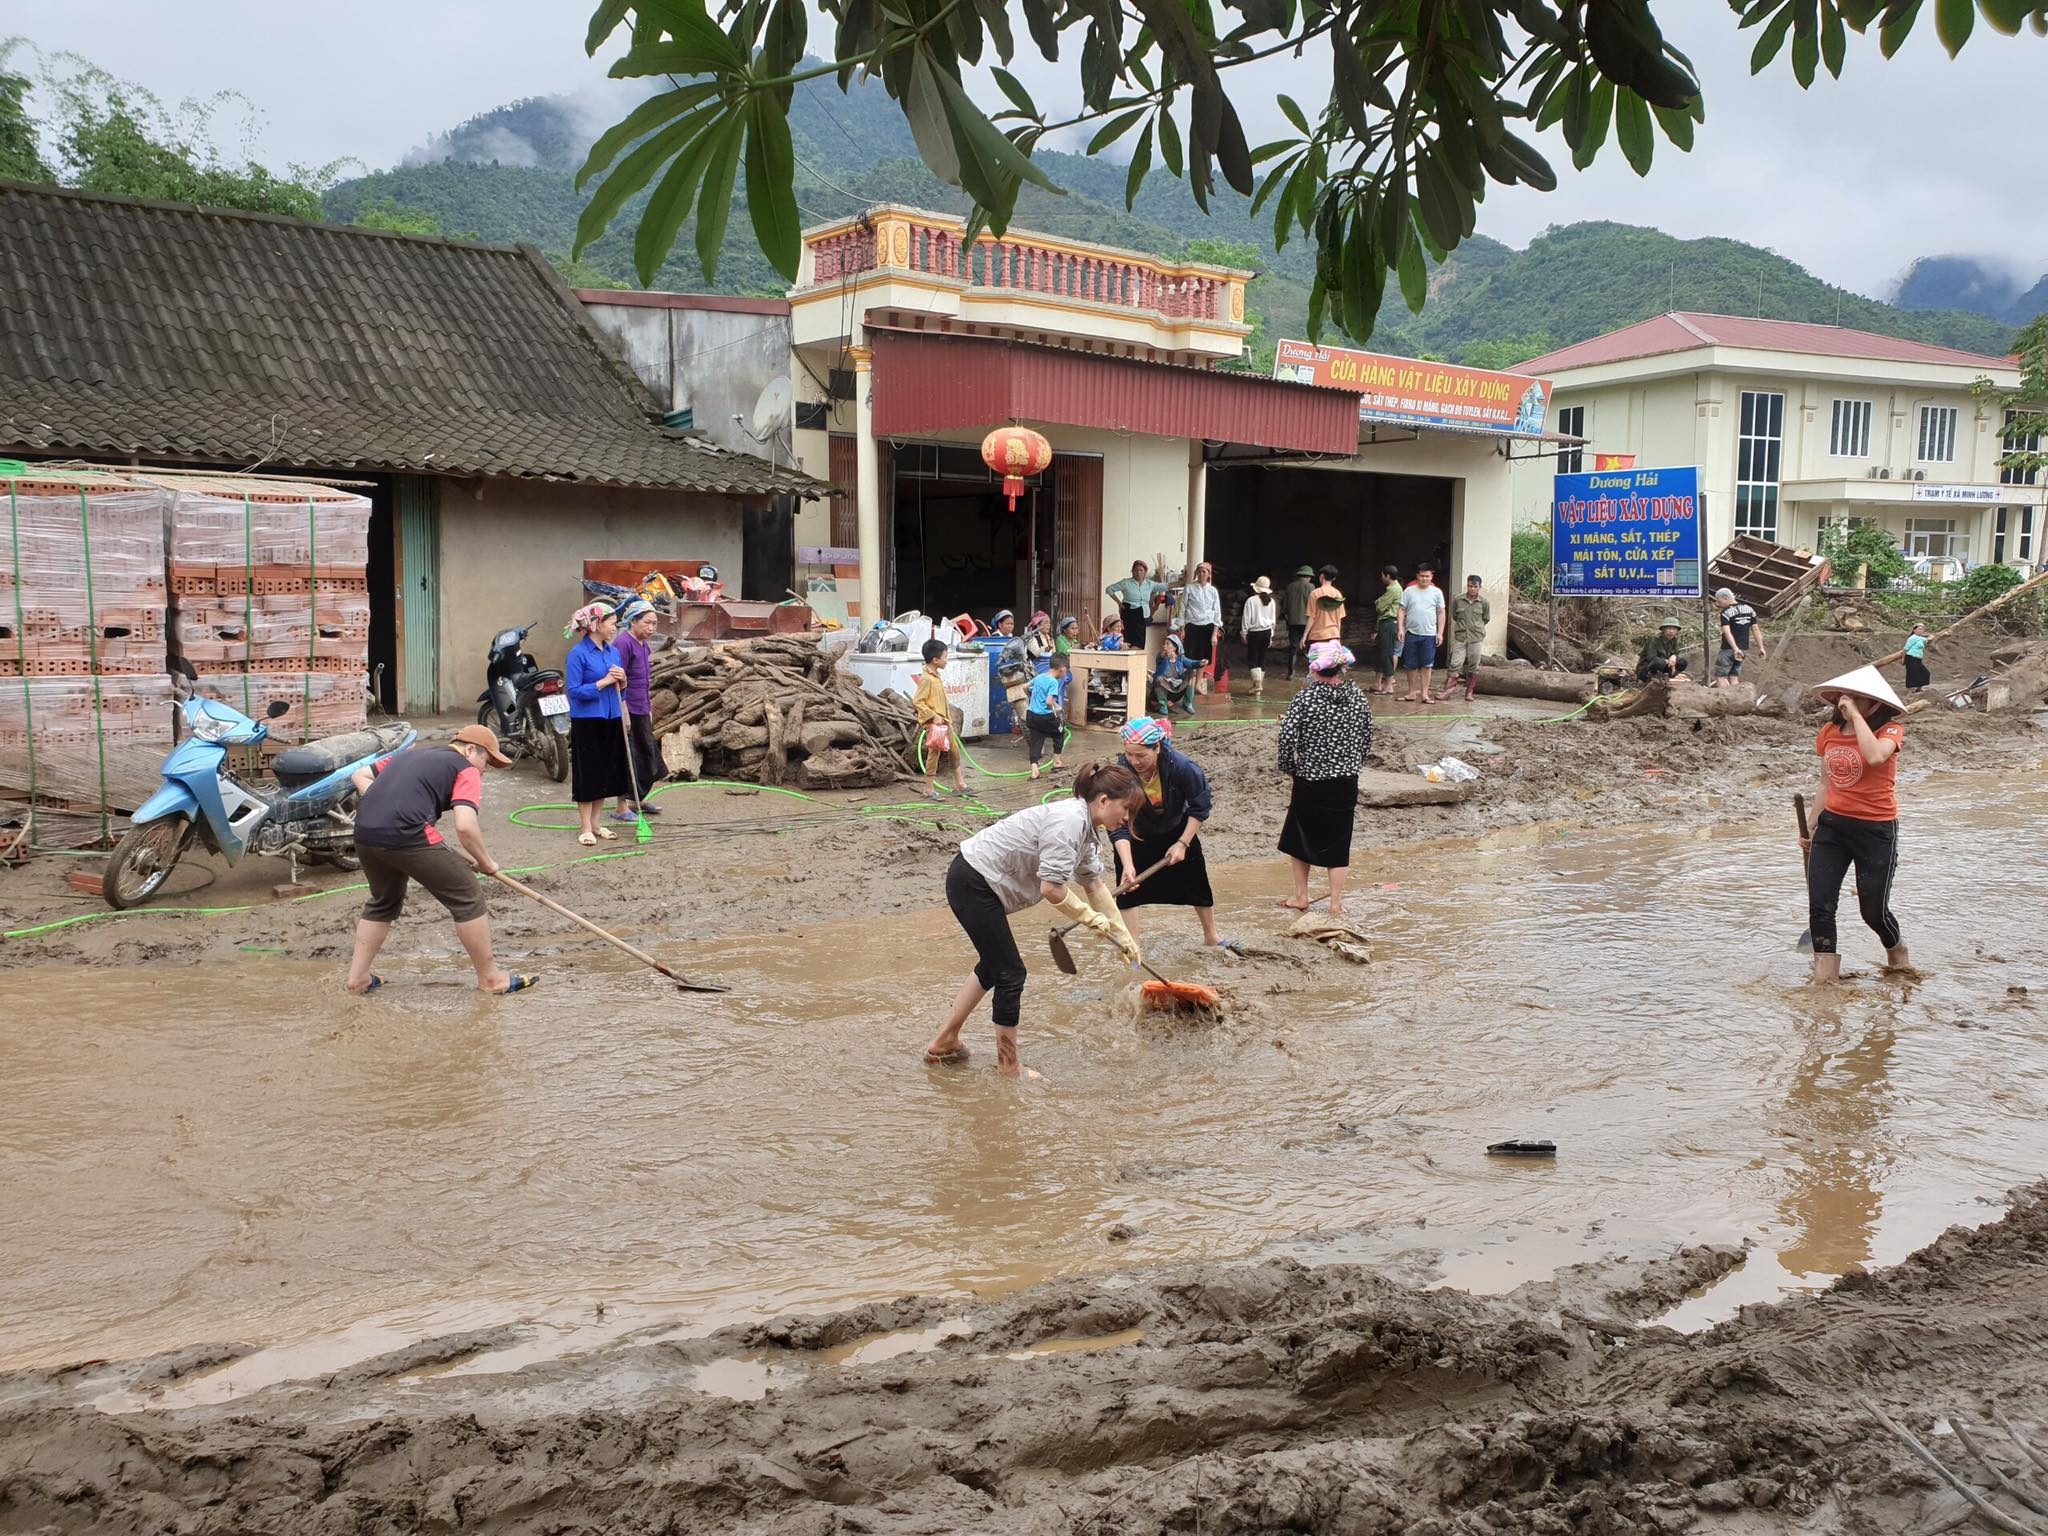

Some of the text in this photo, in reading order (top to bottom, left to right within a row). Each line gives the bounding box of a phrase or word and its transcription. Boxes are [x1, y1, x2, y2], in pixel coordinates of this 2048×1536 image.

[1331, 354, 1510, 403] CỬA HÀNG VẬT LIỆU XÂY DỰNG
[1589, 472, 1658, 489] Dương Hải
[1961, 490, 1976, 499] MINH
[1559, 491, 1693, 528] VẬT LIỆU XÂY DỰNG
[1570, 534, 1580, 544] XI
[1620, 528, 1646, 544] SẮT,
[1649, 529, 1681, 543] THÉP
[1573, 546, 1675, 562] MÁI TÔN, CỬA XẾP
[1594, 564, 1615, 579] SẮT
